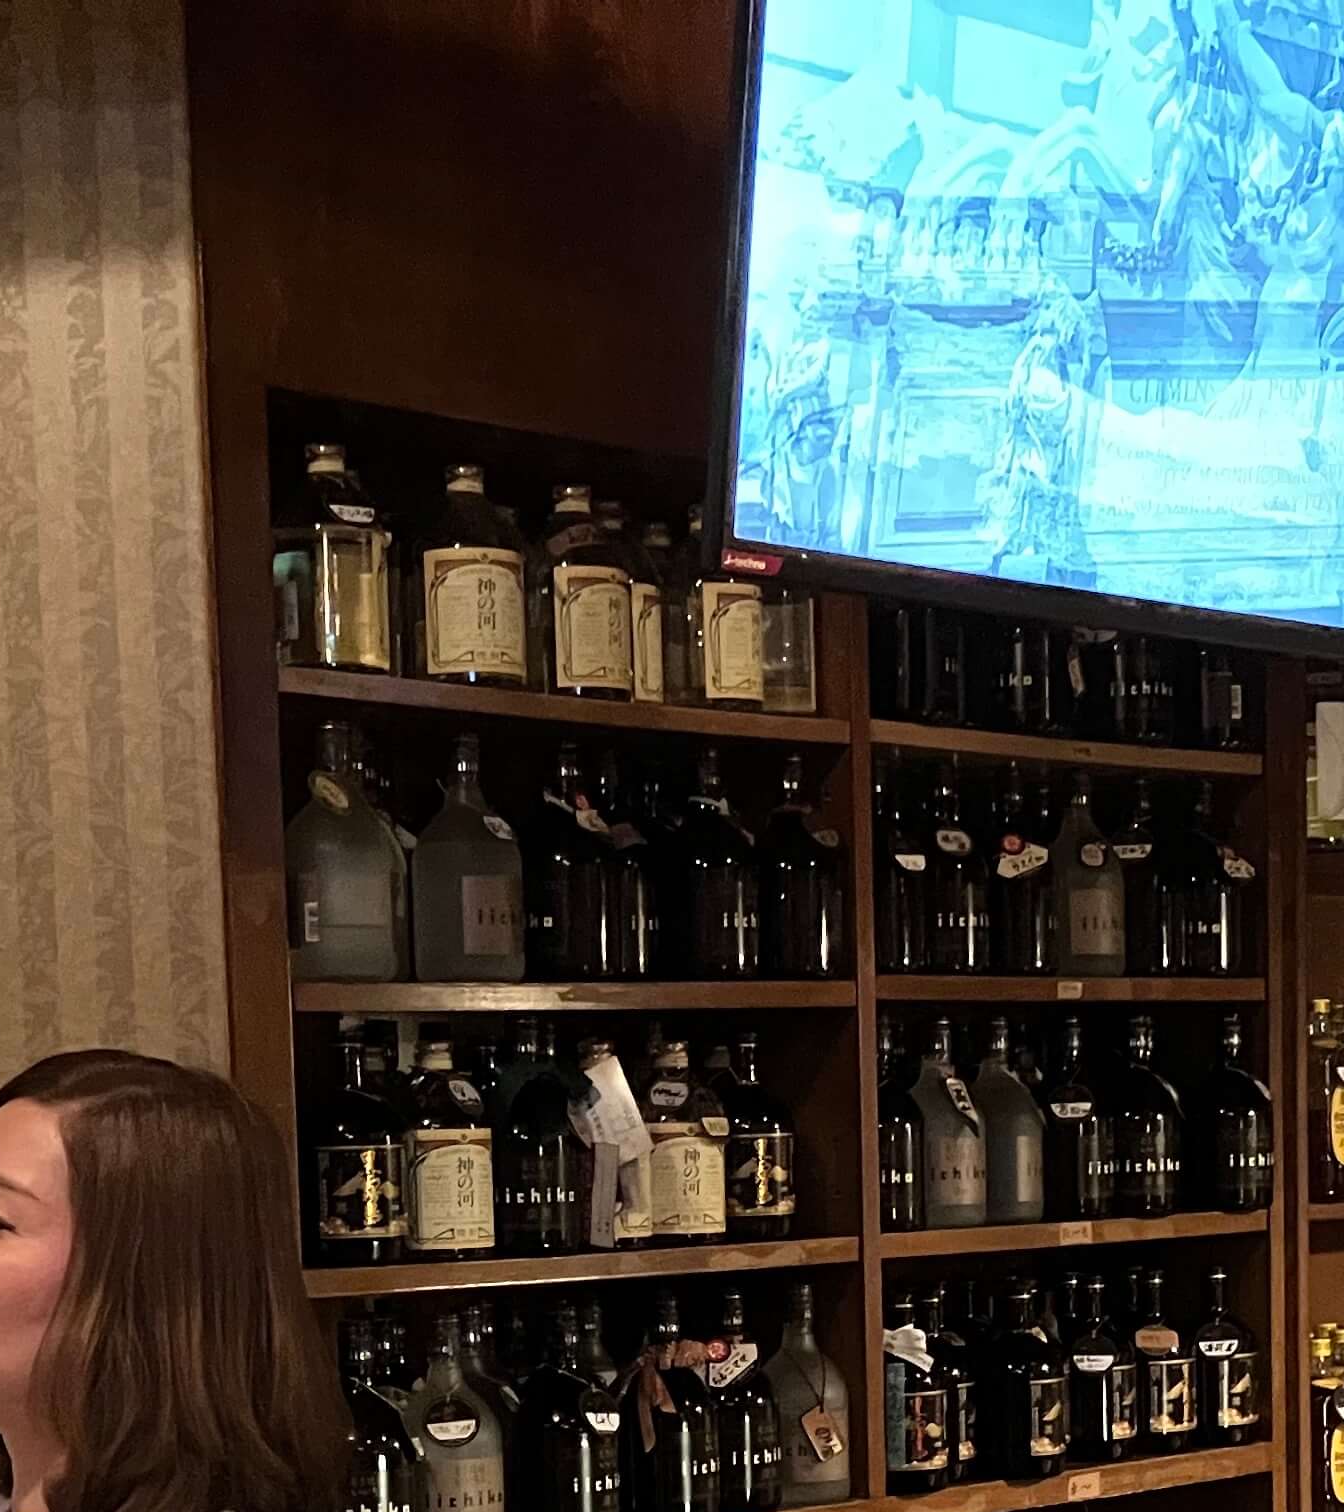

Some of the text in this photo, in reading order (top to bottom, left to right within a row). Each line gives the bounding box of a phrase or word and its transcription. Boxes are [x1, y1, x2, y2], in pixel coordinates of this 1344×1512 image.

[457, 1155, 475, 1209] 神の河
[682, 1147, 701, 1198] 神の河
